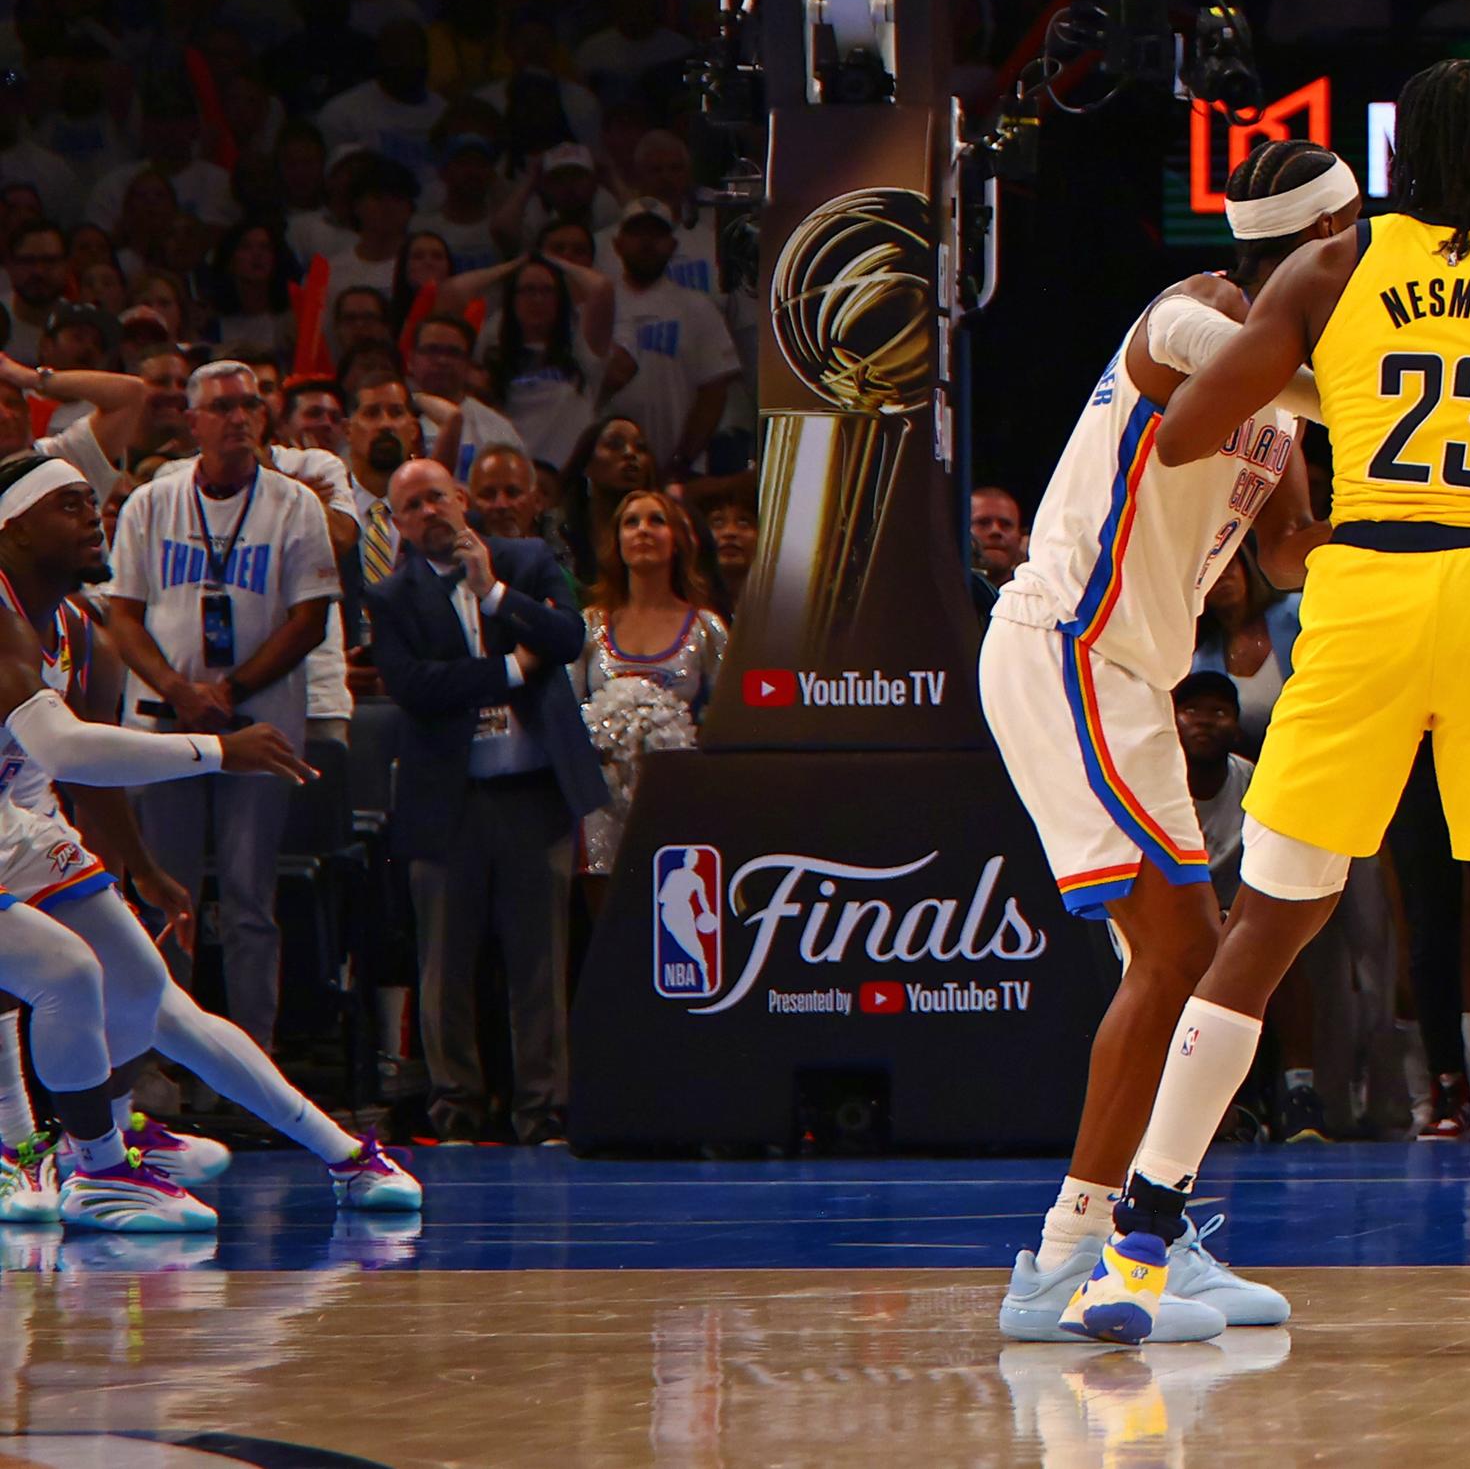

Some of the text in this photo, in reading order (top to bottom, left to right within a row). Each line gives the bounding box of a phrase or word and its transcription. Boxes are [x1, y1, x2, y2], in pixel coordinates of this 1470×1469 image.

[798, 670, 946, 706] YouTube TV
[664, 849, 1047, 1015] NBA Finals
[768, 980, 1031, 1017] Presented by YouTube TV
